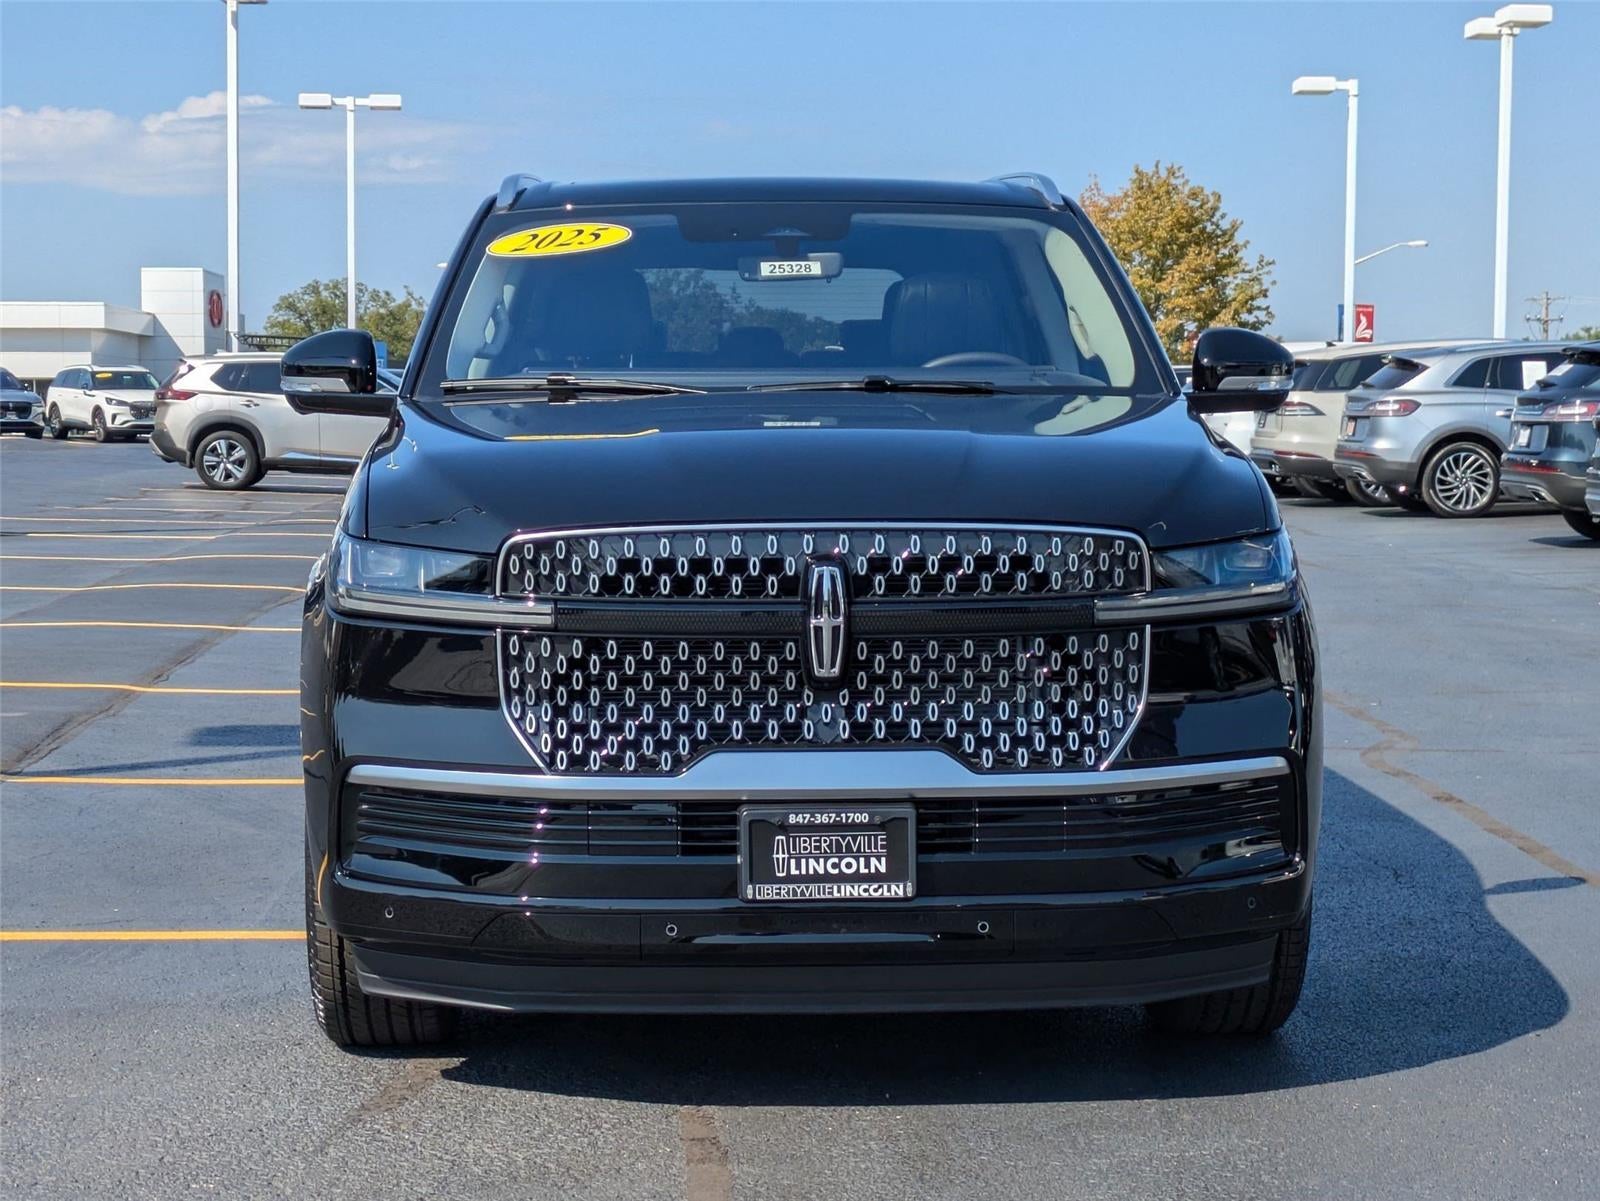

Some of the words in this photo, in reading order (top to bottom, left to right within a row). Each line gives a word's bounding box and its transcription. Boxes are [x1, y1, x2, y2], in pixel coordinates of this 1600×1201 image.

[510, 228, 610, 253] 2025
[768, 263, 812, 274] 25328
[788, 813, 869, 824] 847-367-1700
[789, 835, 887, 854] LIBERTYVILLE
[790, 857, 887, 874] LINCOLN
